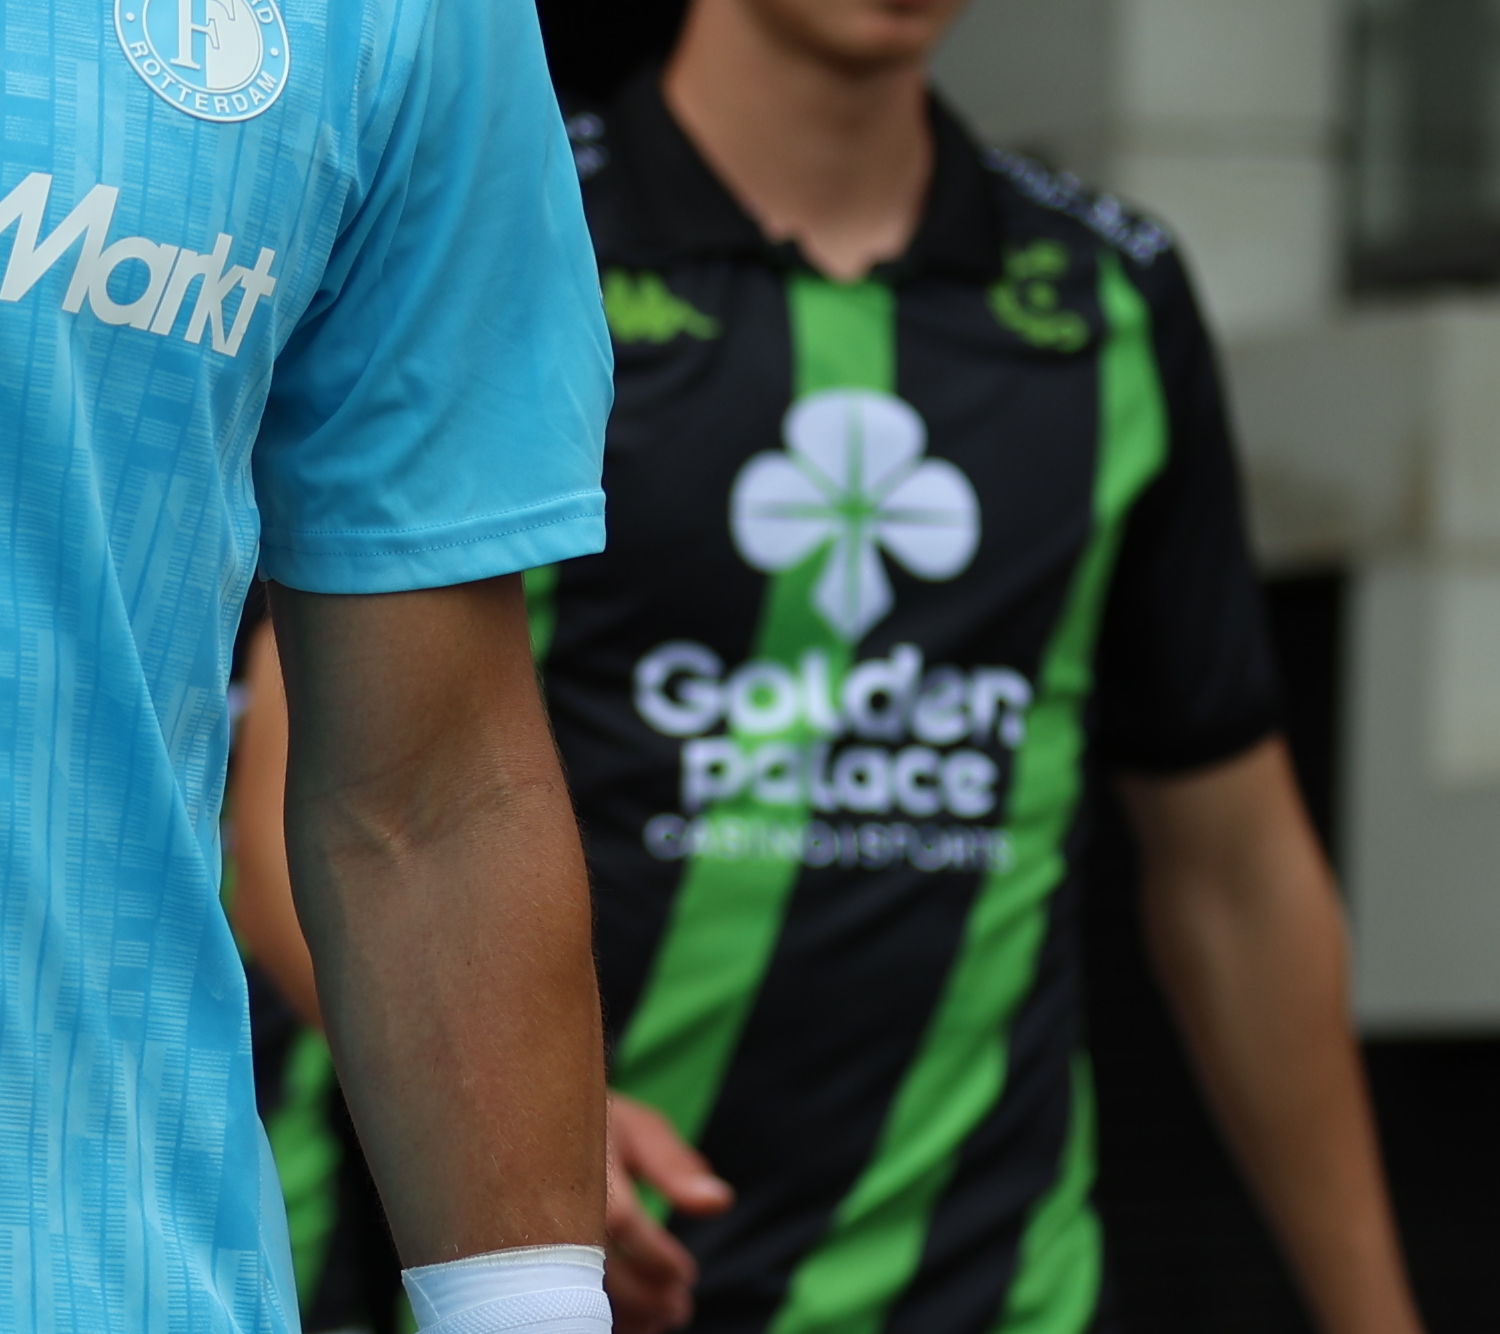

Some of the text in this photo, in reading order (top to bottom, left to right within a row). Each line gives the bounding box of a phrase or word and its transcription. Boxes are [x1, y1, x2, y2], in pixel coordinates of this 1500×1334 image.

[129, 40, 278, 114] ROTTERDAM
[632, 639, 1035, 749] Golden
[680, 736, 998, 818] palace
